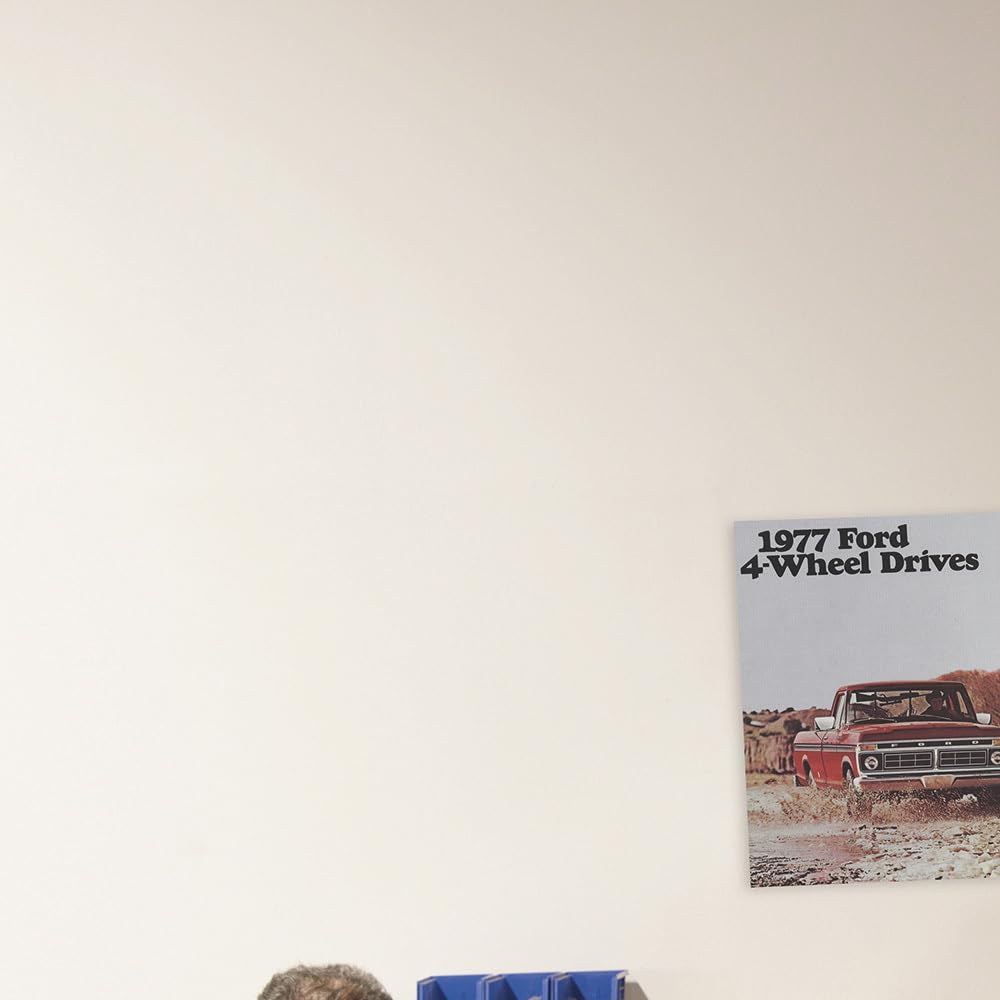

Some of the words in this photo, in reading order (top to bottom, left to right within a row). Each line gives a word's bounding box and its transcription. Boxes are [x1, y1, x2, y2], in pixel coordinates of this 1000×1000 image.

[758, 528, 831, 553] 1977
[837, 523, 910, 550] Ford
[740, 550, 871, 579] 4-Wheel
[880, 550, 980, 574] Drives
